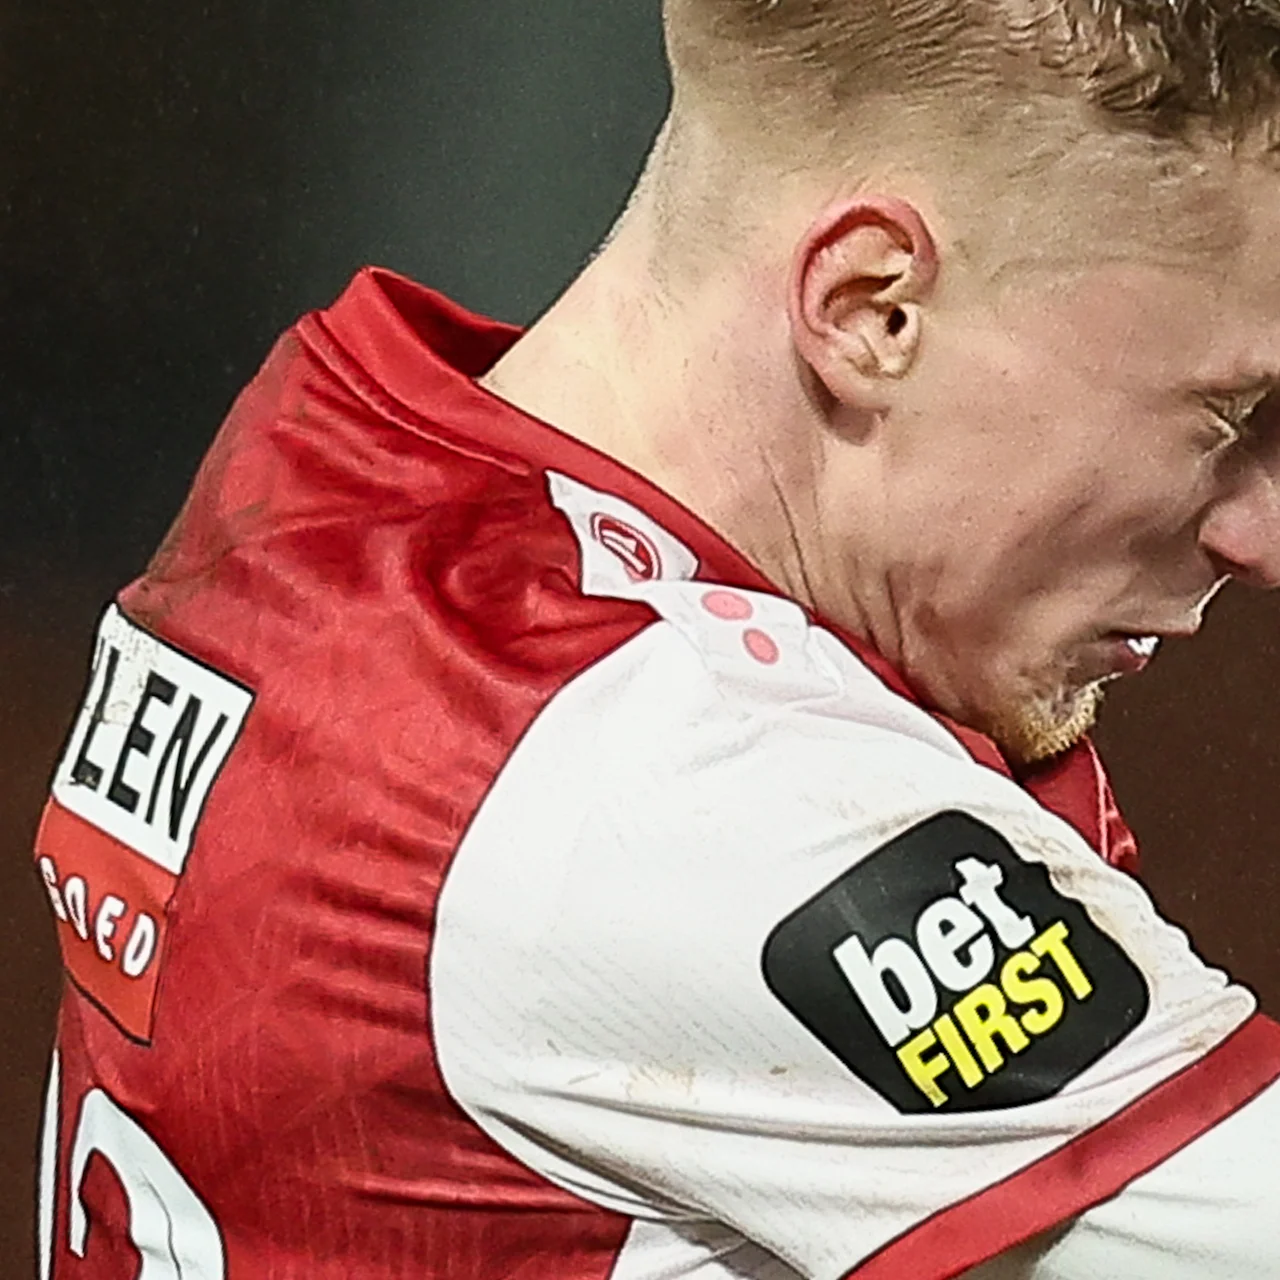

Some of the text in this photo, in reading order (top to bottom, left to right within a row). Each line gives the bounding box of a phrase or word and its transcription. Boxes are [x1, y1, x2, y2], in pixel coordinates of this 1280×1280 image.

[71, 638, 229, 842] LEN
[833, 856, 1036, 1047] bet
[896, 920, 1093, 1108] FIRST
